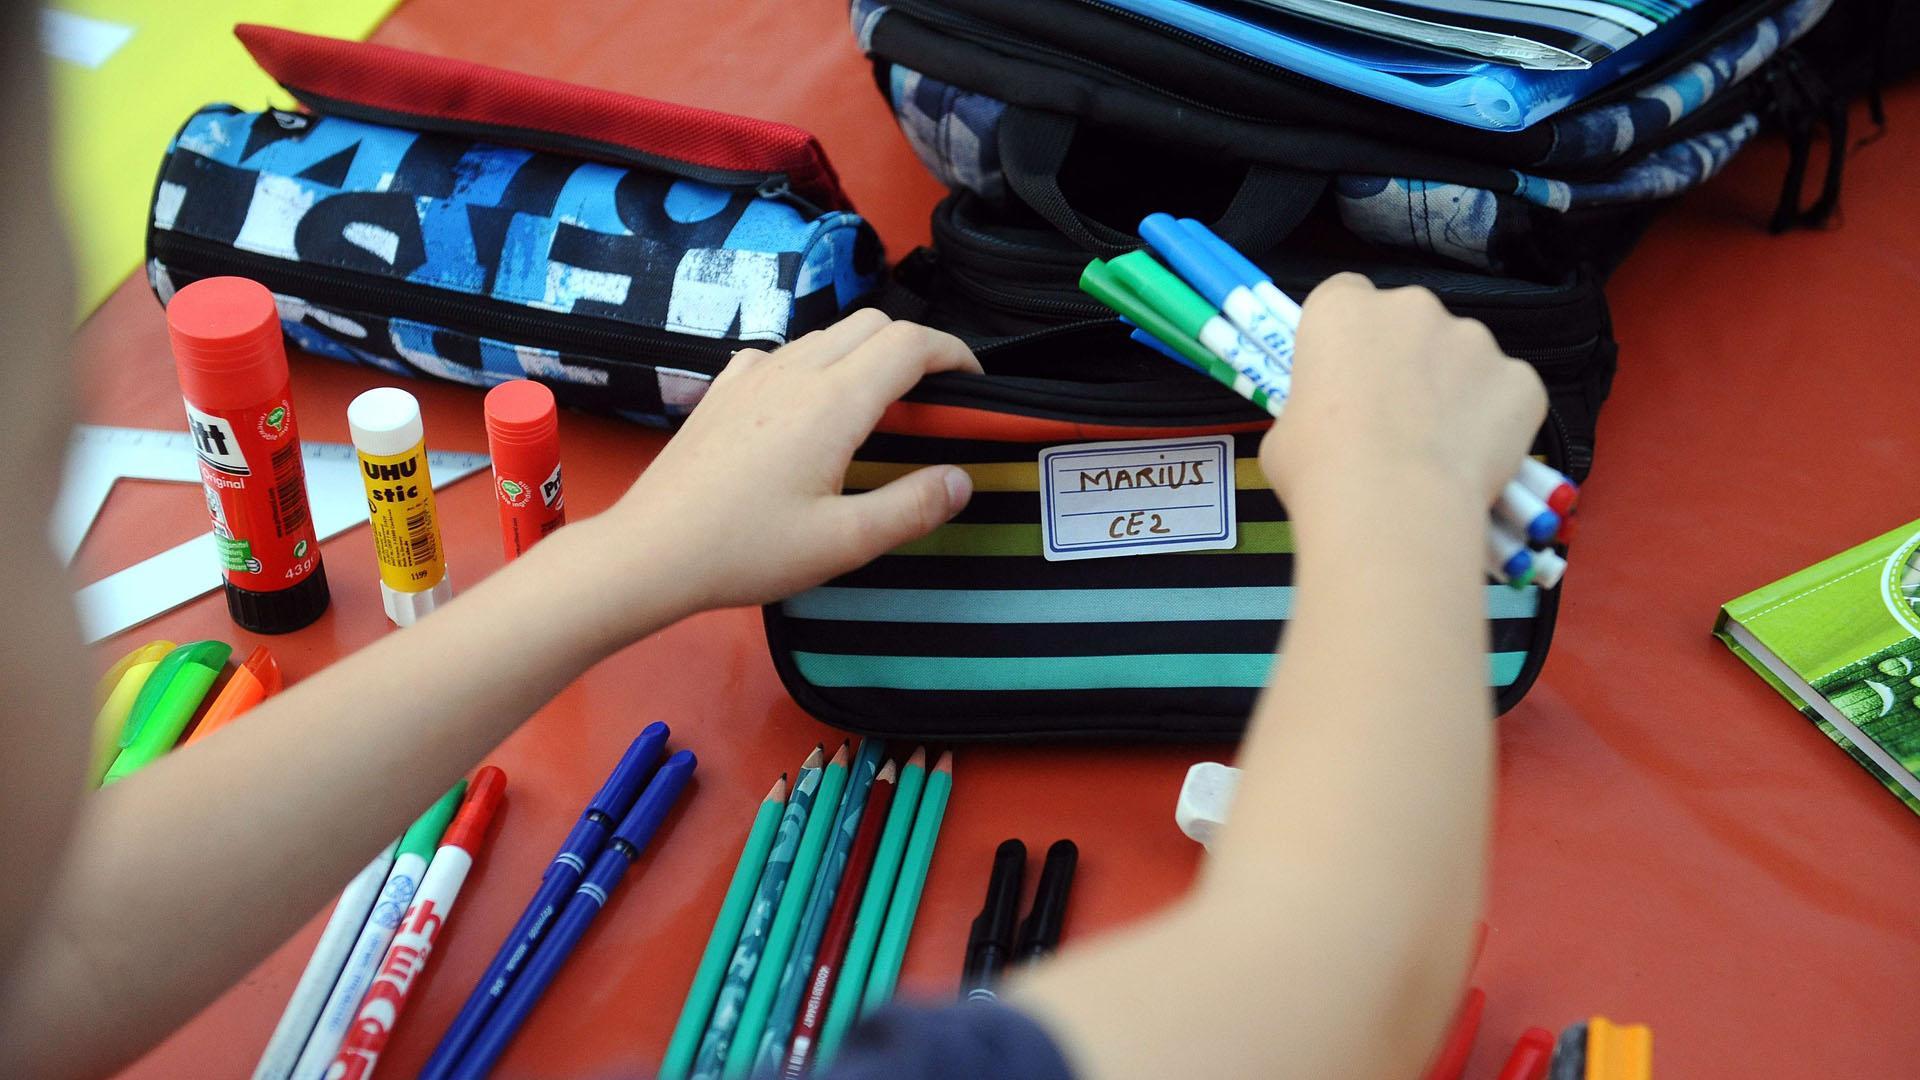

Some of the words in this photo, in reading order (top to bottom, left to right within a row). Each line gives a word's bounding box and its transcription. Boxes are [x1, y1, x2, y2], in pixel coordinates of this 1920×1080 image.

[202, 467, 245, 489] Original
[363, 456, 417, 481] UHU
[372, 485, 418, 503] stic
[411, 569, 428, 581] 1199
